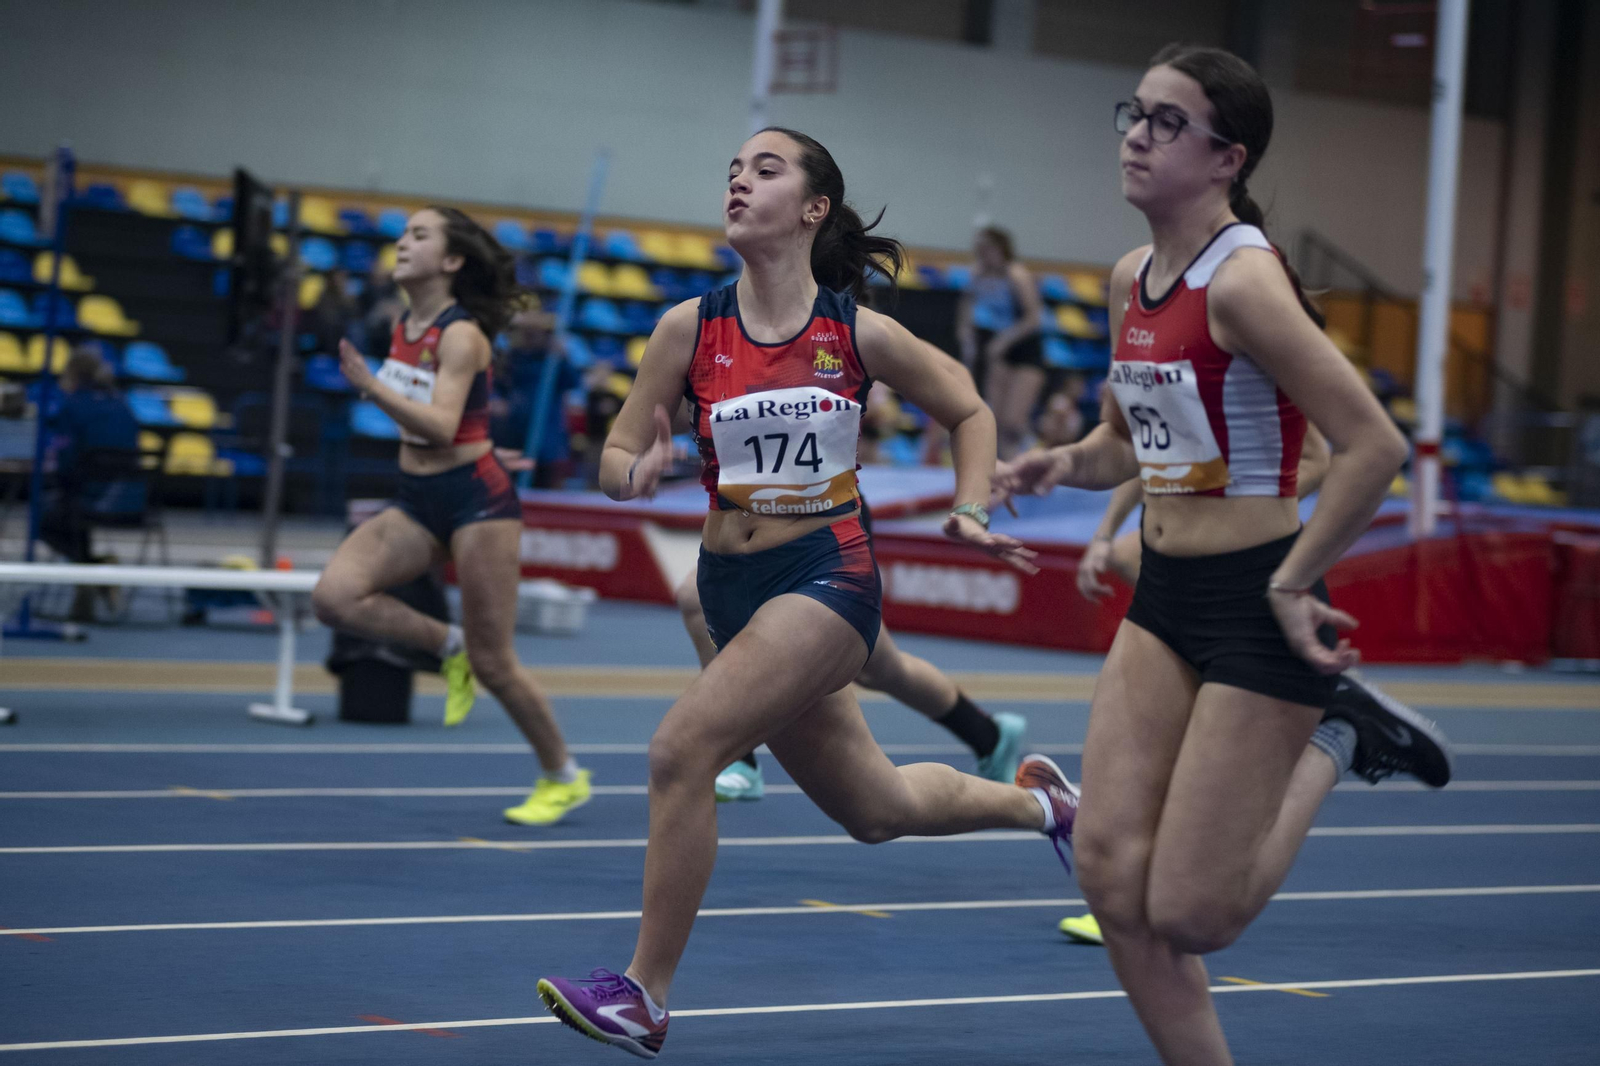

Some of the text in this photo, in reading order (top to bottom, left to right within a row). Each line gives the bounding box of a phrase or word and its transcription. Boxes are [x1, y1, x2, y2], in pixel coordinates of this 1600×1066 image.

[1121, 364, 1182, 392] Región
[715, 395, 852, 423] La Región
[744, 432, 824, 474] 174
[750, 498, 834, 515] telemiño
[890, 563, 1021, 614] MONDO
